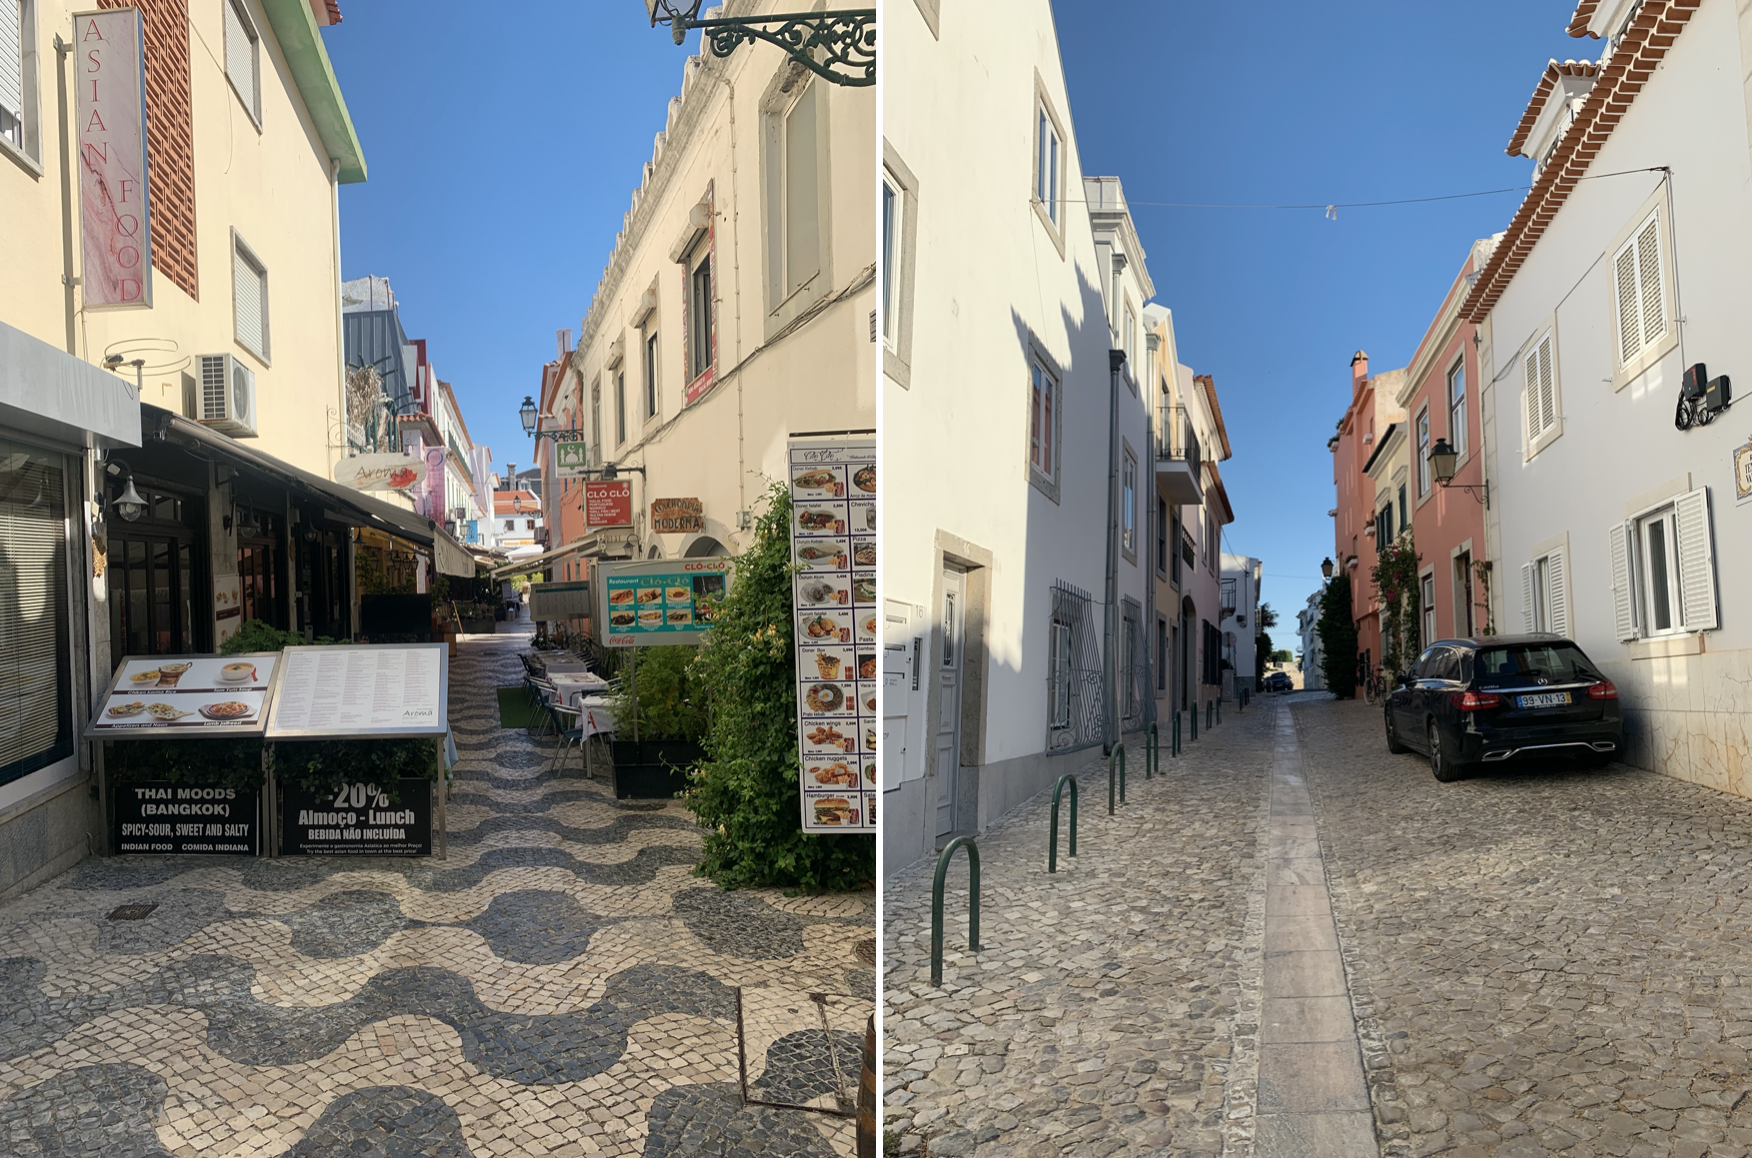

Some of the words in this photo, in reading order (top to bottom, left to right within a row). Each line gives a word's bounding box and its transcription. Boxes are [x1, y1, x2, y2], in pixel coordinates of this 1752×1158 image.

[83, 19, 109, 166] ASIAN
[115, 179, 141, 301] FOOD
[354, 466, 408, 479] Aroma
[587, 490, 607, 499] CLÓ
[609, 488, 630, 497] CLÓ
[654, 517, 700, 530] MODERNA
[916, 604, 924, 618] 16
[1522, 693, 1566, 706] 99-VN-13
[135, 788, 172, 799] THAI
[177, 788, 236, 799] MOODS
[328, 782, 389, 808] -20%
[141, 804, 230, 817] (BANGKOK)
[298, 810, 357, 828] Almoço
[368, 809, 415, 825] Lunch
[122, 823, 174, 838] SPICY-SOUR,
[176, 824, 203, 836] SWEET
[206, 824, 222, 836] AND
[225, 824, 249, 836] SALTY
[308, 829, 342, 840] BEBIDA
[343, 827, 361, 840] NÃO
[363, 827, 406, 840] INCLUÍDA
